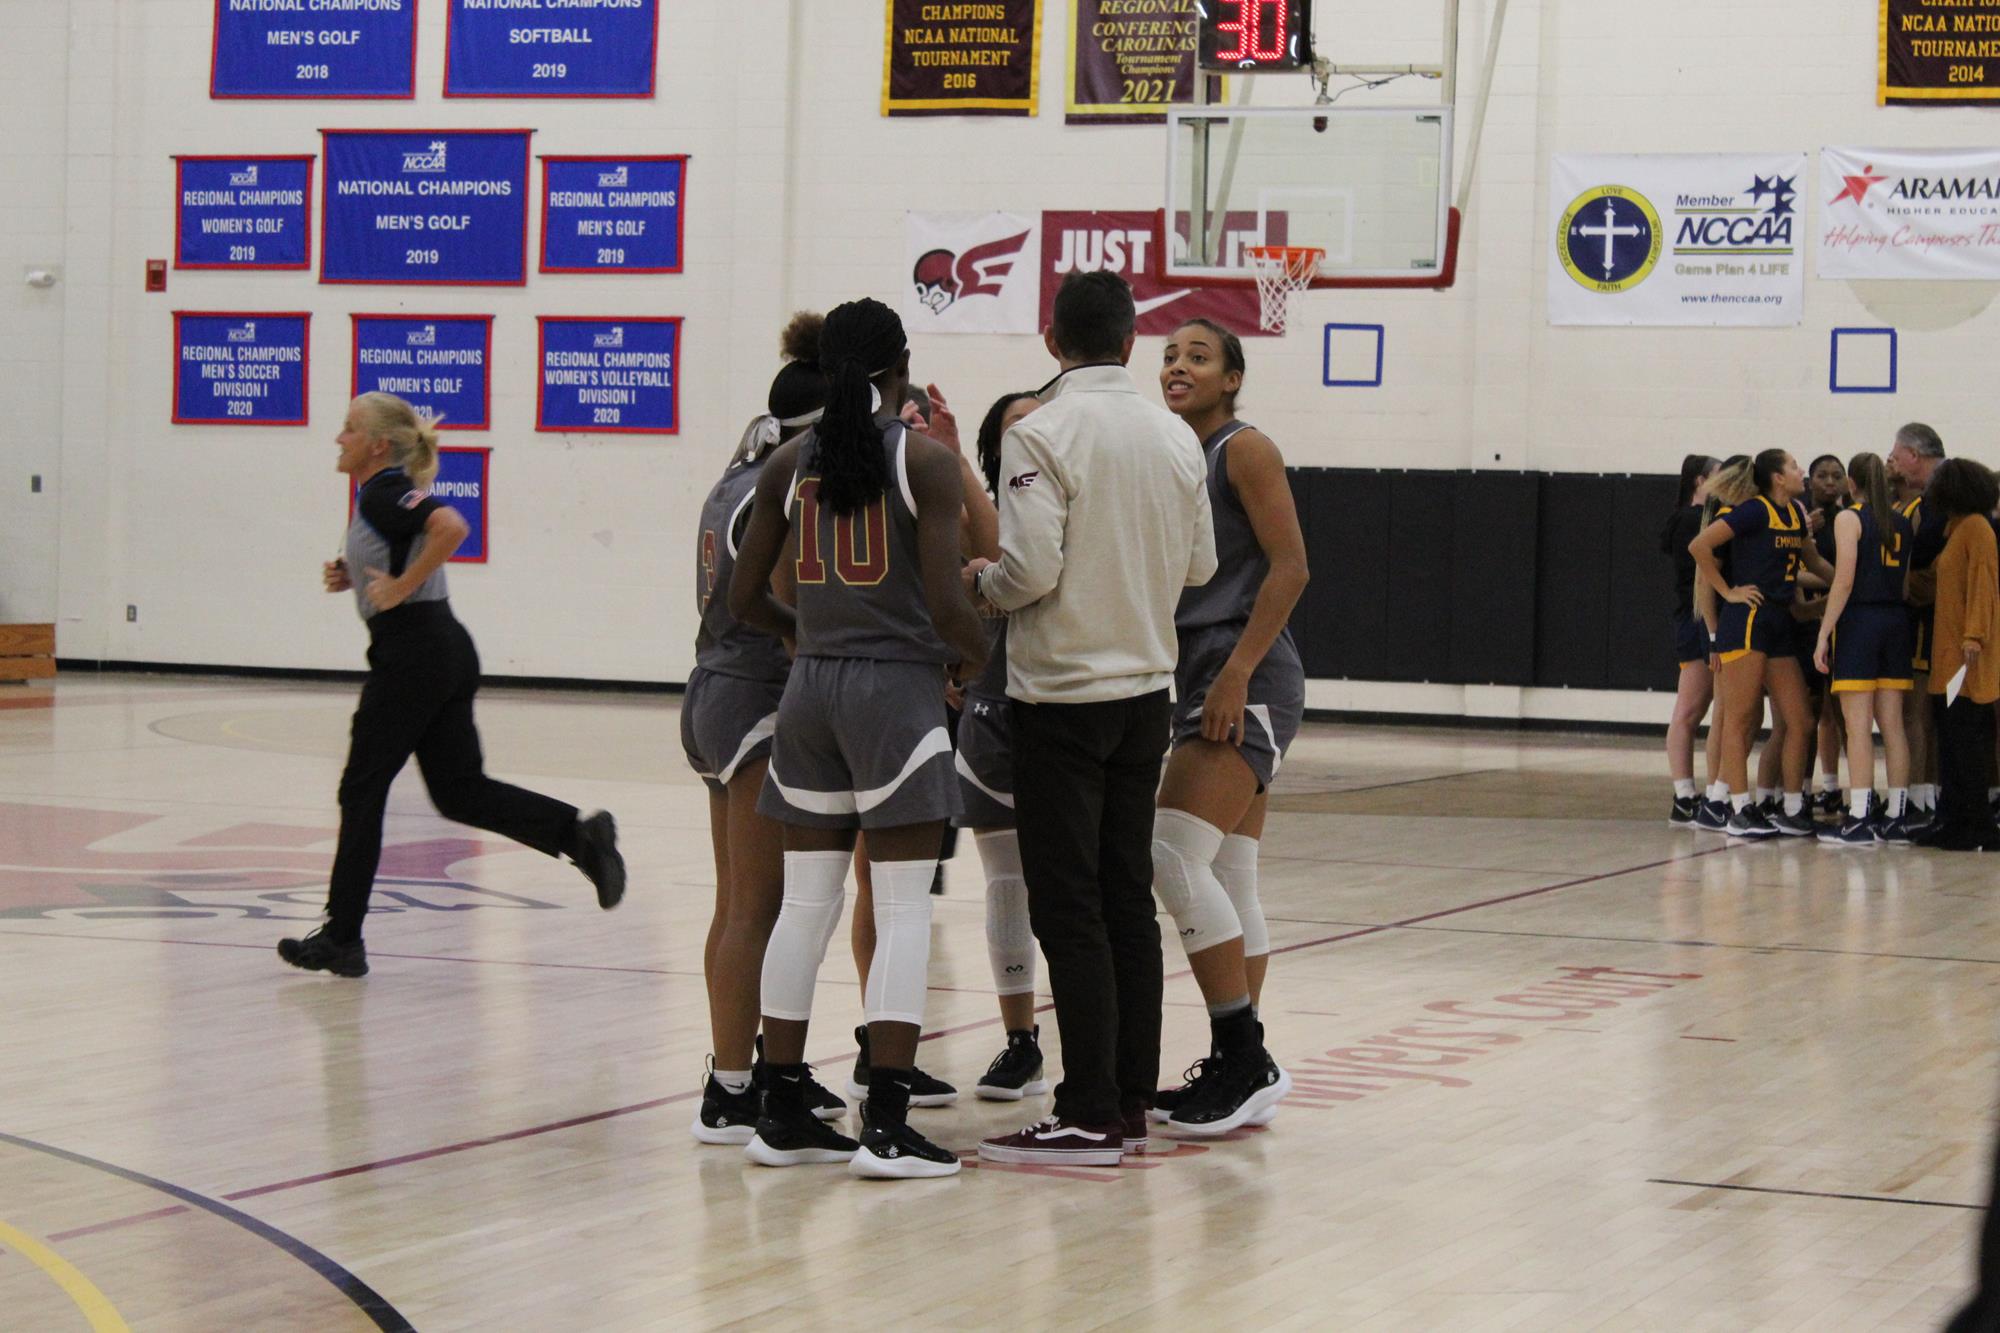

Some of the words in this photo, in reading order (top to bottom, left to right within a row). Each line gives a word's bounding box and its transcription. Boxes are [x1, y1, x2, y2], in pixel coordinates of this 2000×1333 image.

[229, 0, 304, 11] NATIONAL
[309, 0, 401, 11] CHAMPIONS
[463, 0, 542, 9] NATIONAL
[546, 0, 642, 8] CHAMPIONS
[922, 5, 1006, 20] CHAMPIONS
[1092, 20, 1196, 36] CONFERENC
[1216, 0, 1287, 61] 30
[1901, 14, 1947, 32] NCAA
[1953, 14, 2000, 32] NATIO
[267, 31, 315, 45] MEN'S
[318, 31, 361, 45] GOLF
[509, 29, 592, 43] SOFTBALL
[904, 29, 945, 44] NCAA
[949, 28, 1019, 44] NATIONAL
[1101, 36, 1197, 52] CAROLINAS
[1911, 39, 2000, 57] TOURNAME
[912, 50, 1011, 66] TOURNAMENT
[1116, 53, 1182, 64] Tournament
[296, 65, 329, 79] 2018
[532, 63, 567, 78] 2019
[1121, 64, 1176, 76] Champions
[1948, 65, 1984, 82] 2014
[943, 73, 977, 89] 2016
[1119, 79, 1177, 103] 2021
[338, 181, 414, 195] NATIONAL
[418, 181, 512, 195] CHAMPIONS
[184, 191, 236, 206] REGIONAL
[239, 190, 303, 206] CHAMPIONS
[550, 192, 605, 207] REGIONAL
[608, 191, 676, 207] CHAMPIONS
[1676, 194, 1735, 207] Member
[1887, 207, 1941, 215] HIGHER
[1950, 207, 1998, 215] EDUCA
[201, 218, 253, 233] WOMEN'S
[256, 218, 284, 233] GOLF
[376, 215, 424, 230] MEN'S
[428, 215, 471, 230] GOLF
[578, 220, 613, 236] MEN'S
[616, 220, 646, 236] GOLF
[1675, 216, 1792, 245] NCCAA
[1978, 223, 2000, 247] Th
[229, 245, 255, 261] 2019
[406, 250, 439, 264] 2019
[597, 248, 624, 264] 2019
[1054, 230, 1152, 274] JUST
[1675, 263, 1712, 276] Game
[1715, 263, 1745, 276] Plan
[1748, 263, 1757, 276] 4
[1759, 263, 1790, 276] LIFE
[1681, 293, 1782, 305] www.thenccaa.org
[182, 345, 235, 360] REGIONAL
[237, 346, 301, 362] CHAMPIONS
[360, 349, 414, 364] REGIONAL
[417, 349, 482, 365] CHAMPIONS
[546, 352, 600, 367] REGIONAL
[603, 352, 671, 368] CHAMPIONS
[201, 364, 235, 379] MEN'S
[238, 364, 280, 379] SOCCER
[545, 370, 598, 385] WOMEN'S
[601, 371, 671, 387] VOLLEYBALL
[213, 382, 261, 397] DIVISION
[264, 383, 268, 397] I
[378, 377, 431, 393] WOMEN'S
[433, 378, 463, 393] GOLF
[579, 388, 629, 404] DIVISION
[631, 389, 636, 405] I
[227, 400, 253, 416] 2020
[413, 405, 433, 420] 020
[593, 408, 620, 423] 2020
[427, 481, 480, 498] AMPIONS
[796, 477, 888, 585] 10
[1784, 553, 1796, 581] 2
